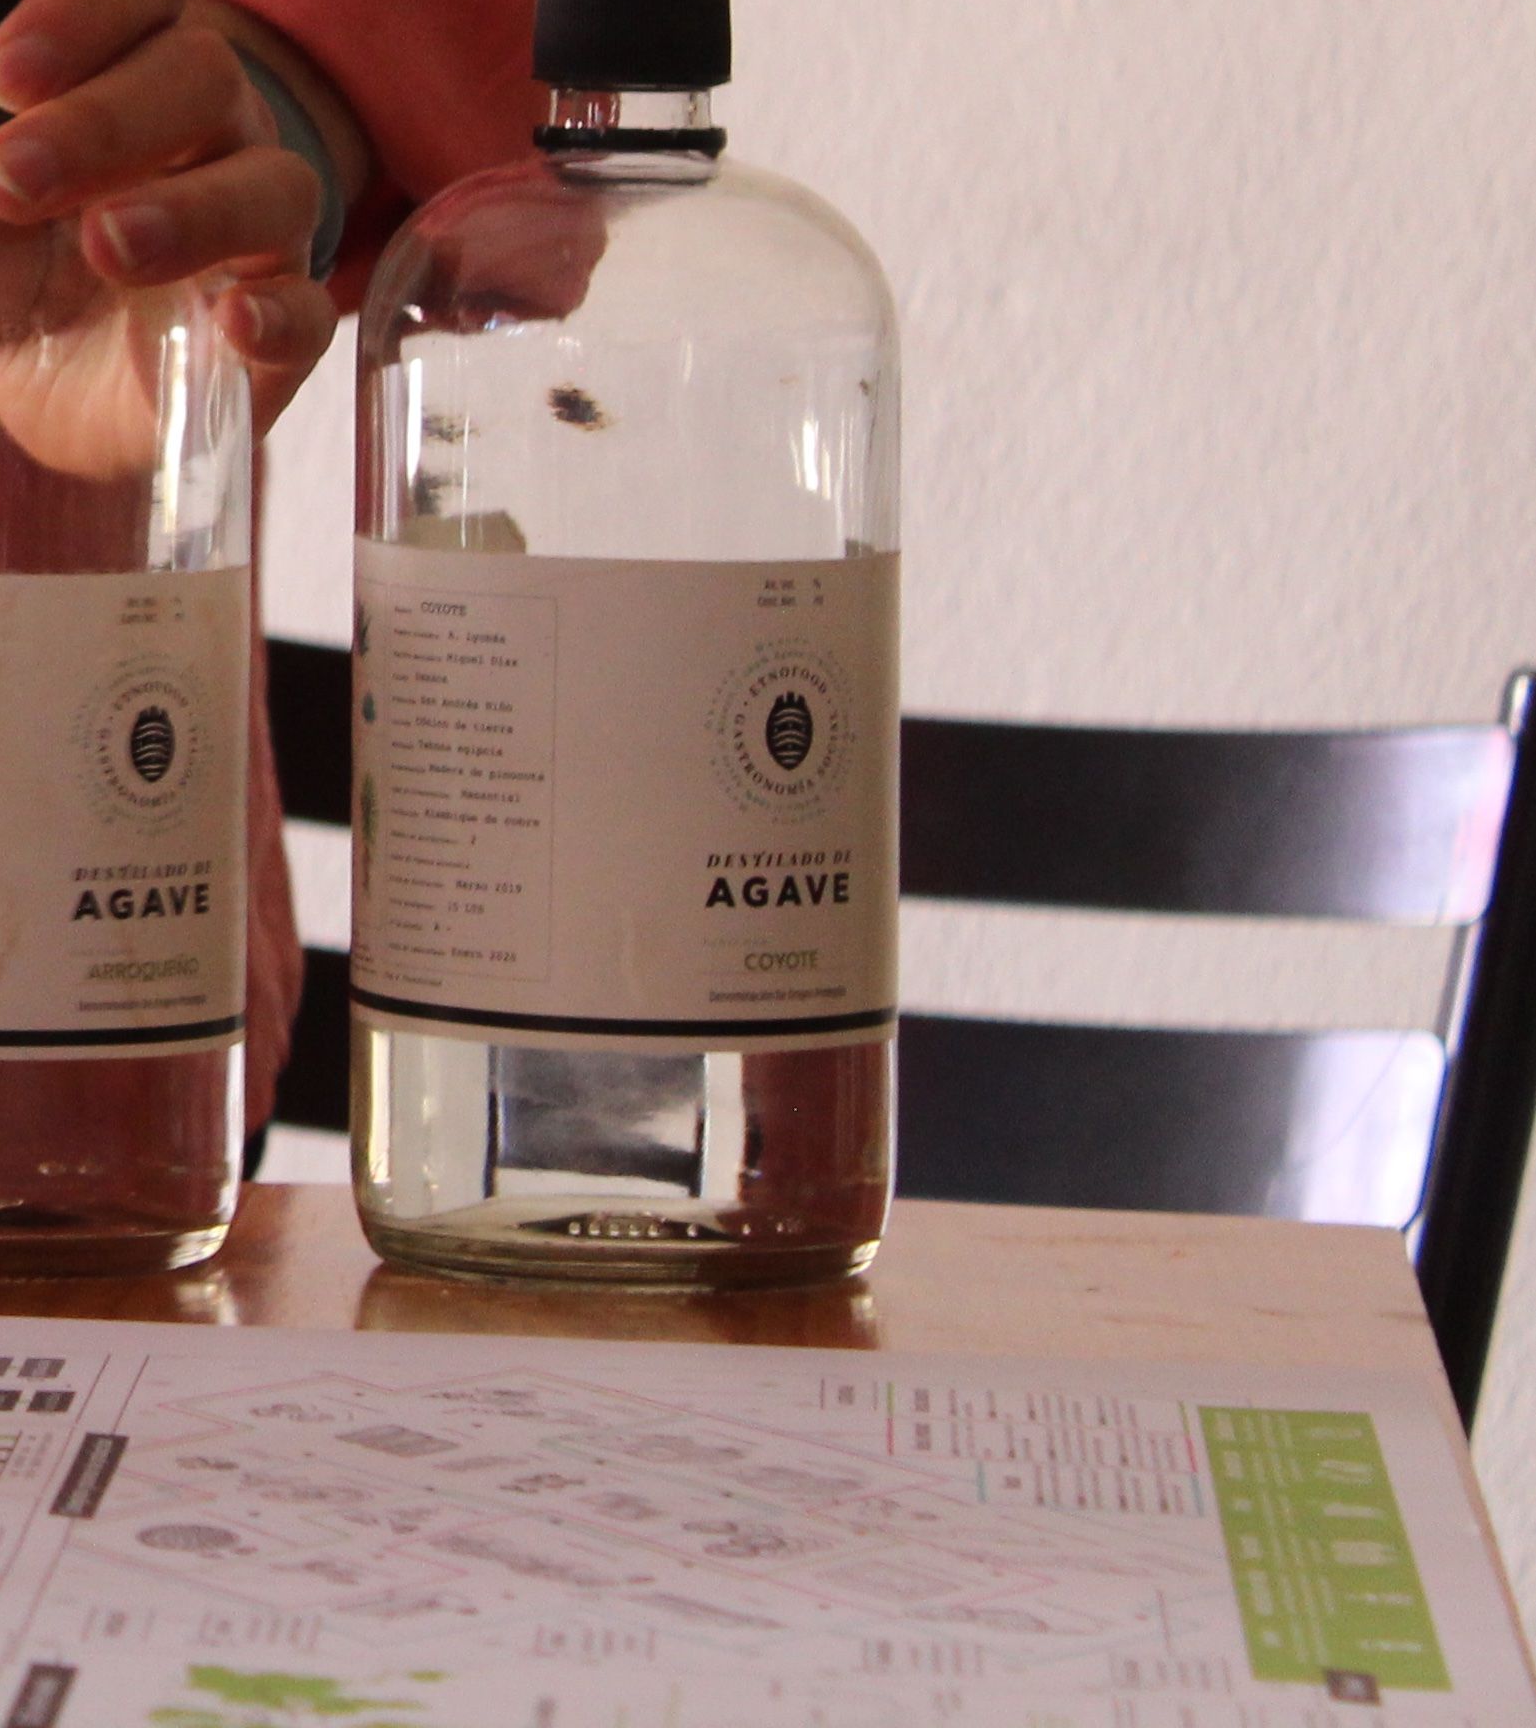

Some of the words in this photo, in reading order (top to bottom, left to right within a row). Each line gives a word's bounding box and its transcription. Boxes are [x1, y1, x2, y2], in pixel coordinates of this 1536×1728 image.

[706, 850, 826, 869] DESTILADO
[833, 849, 852, 865] DE
[72, 883, 210, 920] AGAVE
[705, 872, 850, 909] AGAVE
[744, 948, 819, 972] COYOTE
